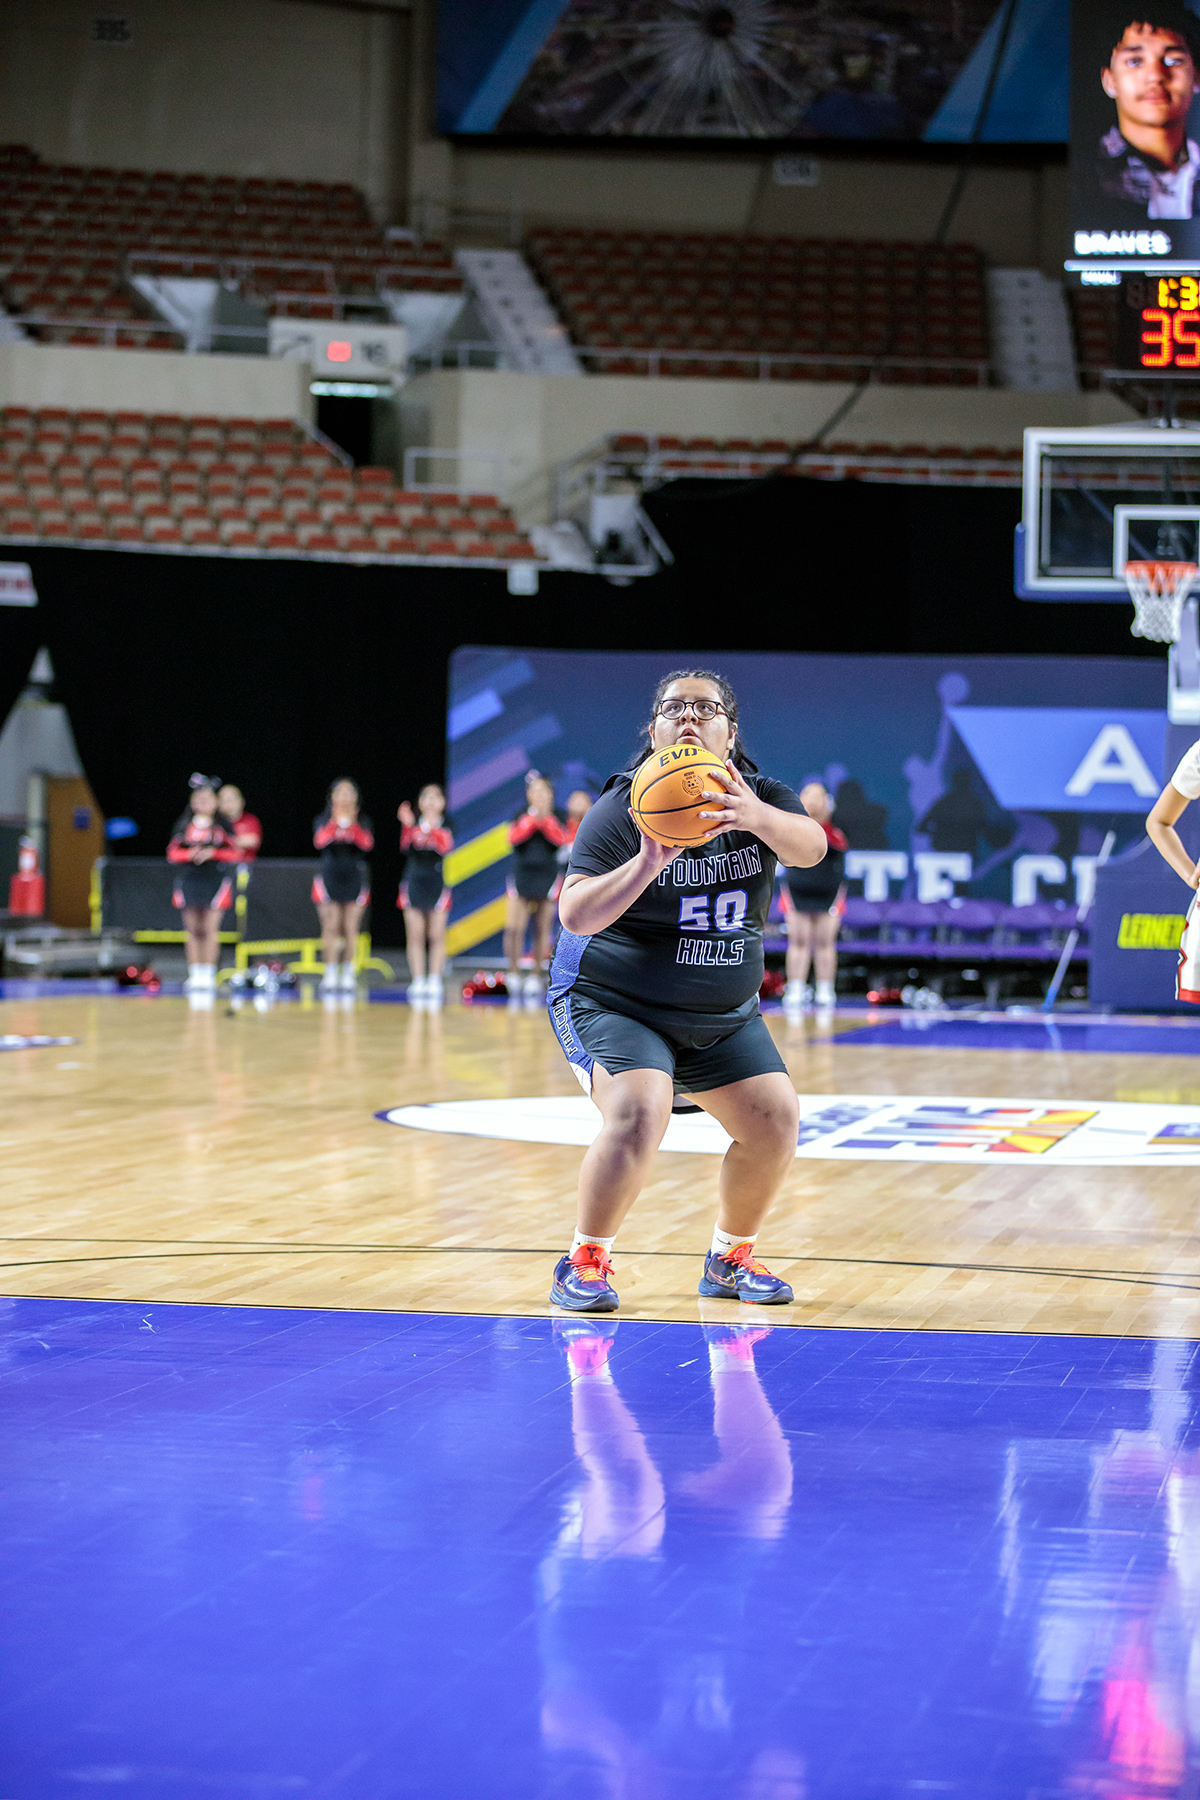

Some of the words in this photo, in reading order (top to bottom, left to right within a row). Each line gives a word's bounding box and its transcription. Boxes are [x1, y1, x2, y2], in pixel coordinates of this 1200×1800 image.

[1074, 230, 1172, 255] BRAVES
[1158, 276, 1200, 310] 1:3
[1141, 308, 1200, 367] 35
[659, 748, 698, 768] EVO
[1064, 723, 1160, 797] A
[658, 844, 762, 887] FOUNTAIN
[678, 888, 748, 932] 50
[676, 938, 745, 966] HILLS
